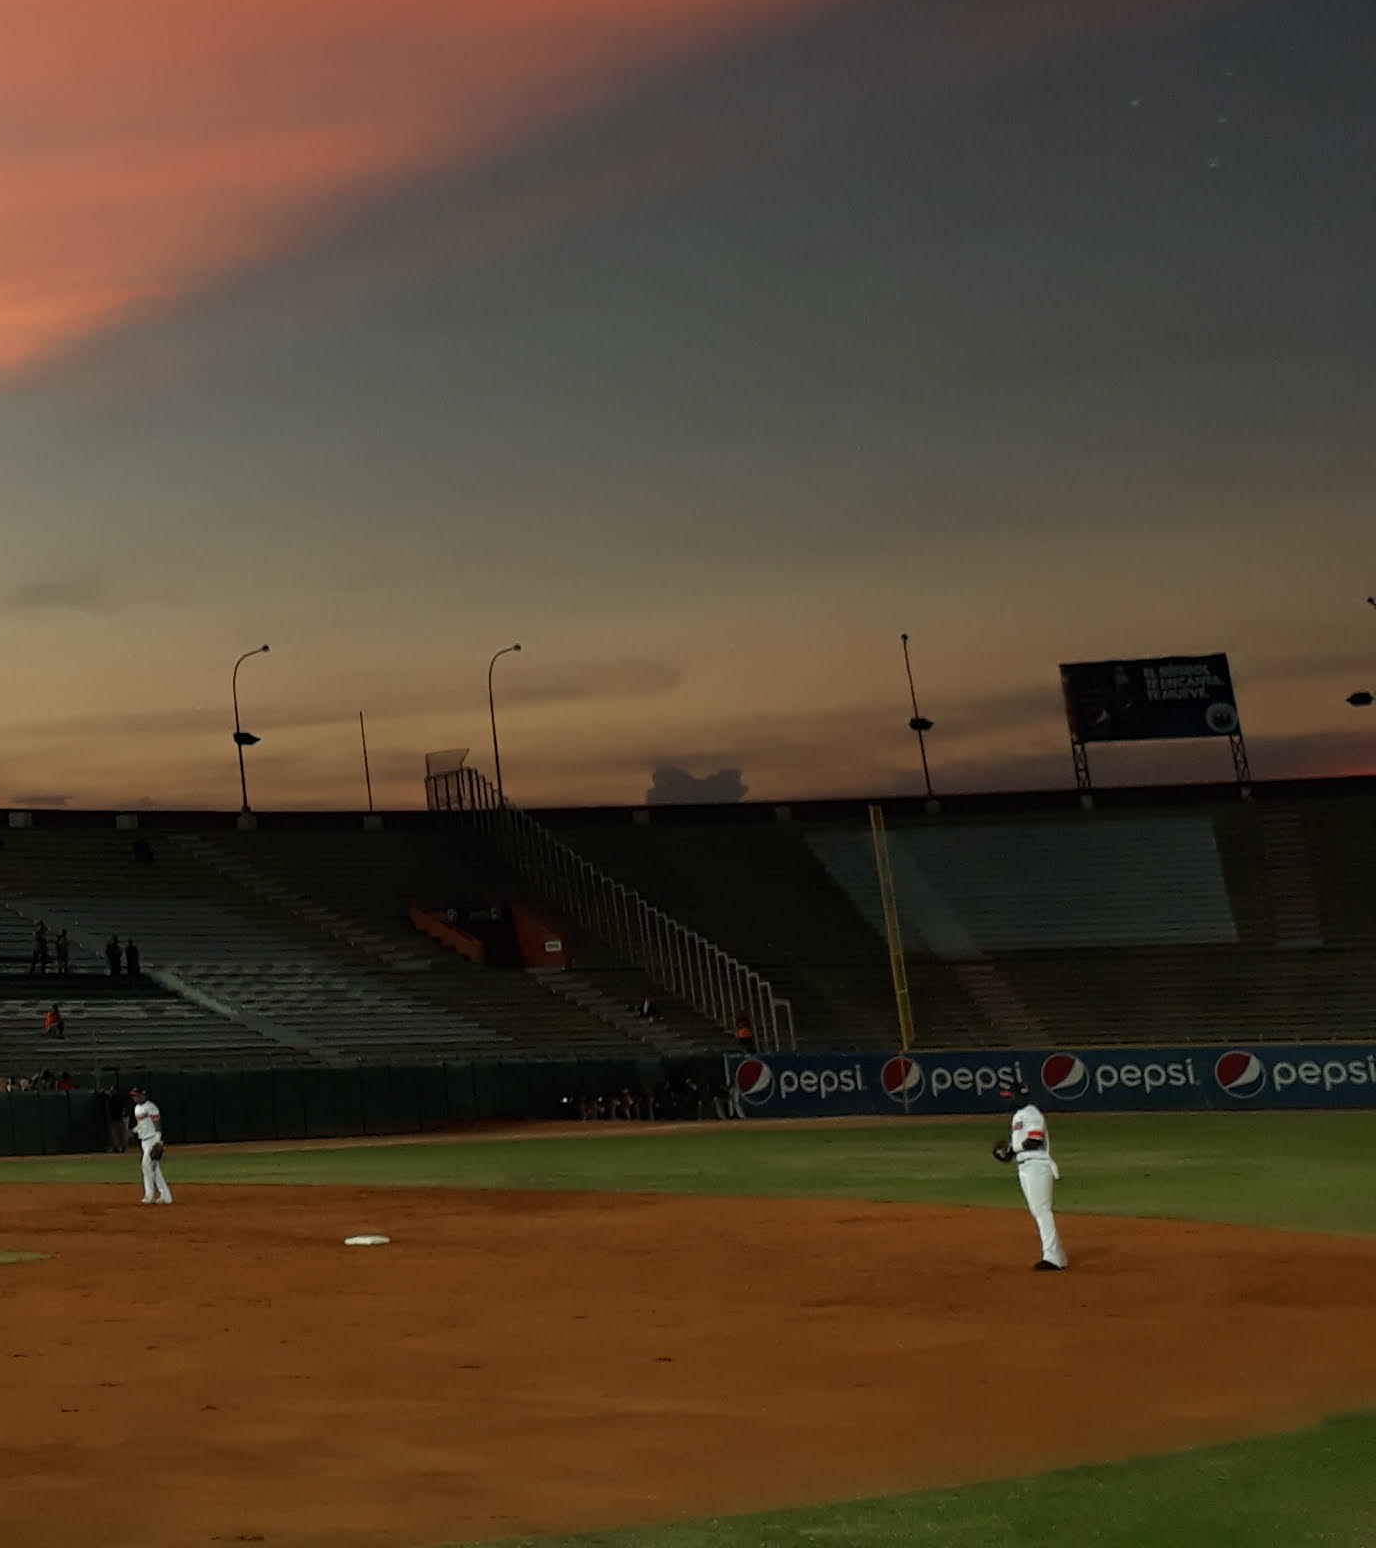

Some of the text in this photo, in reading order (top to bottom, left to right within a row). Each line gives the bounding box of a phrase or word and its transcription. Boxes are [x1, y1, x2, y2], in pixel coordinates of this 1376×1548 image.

[779, 1054, 1376, 1100] pepsi pepsi pepsi pepsi
